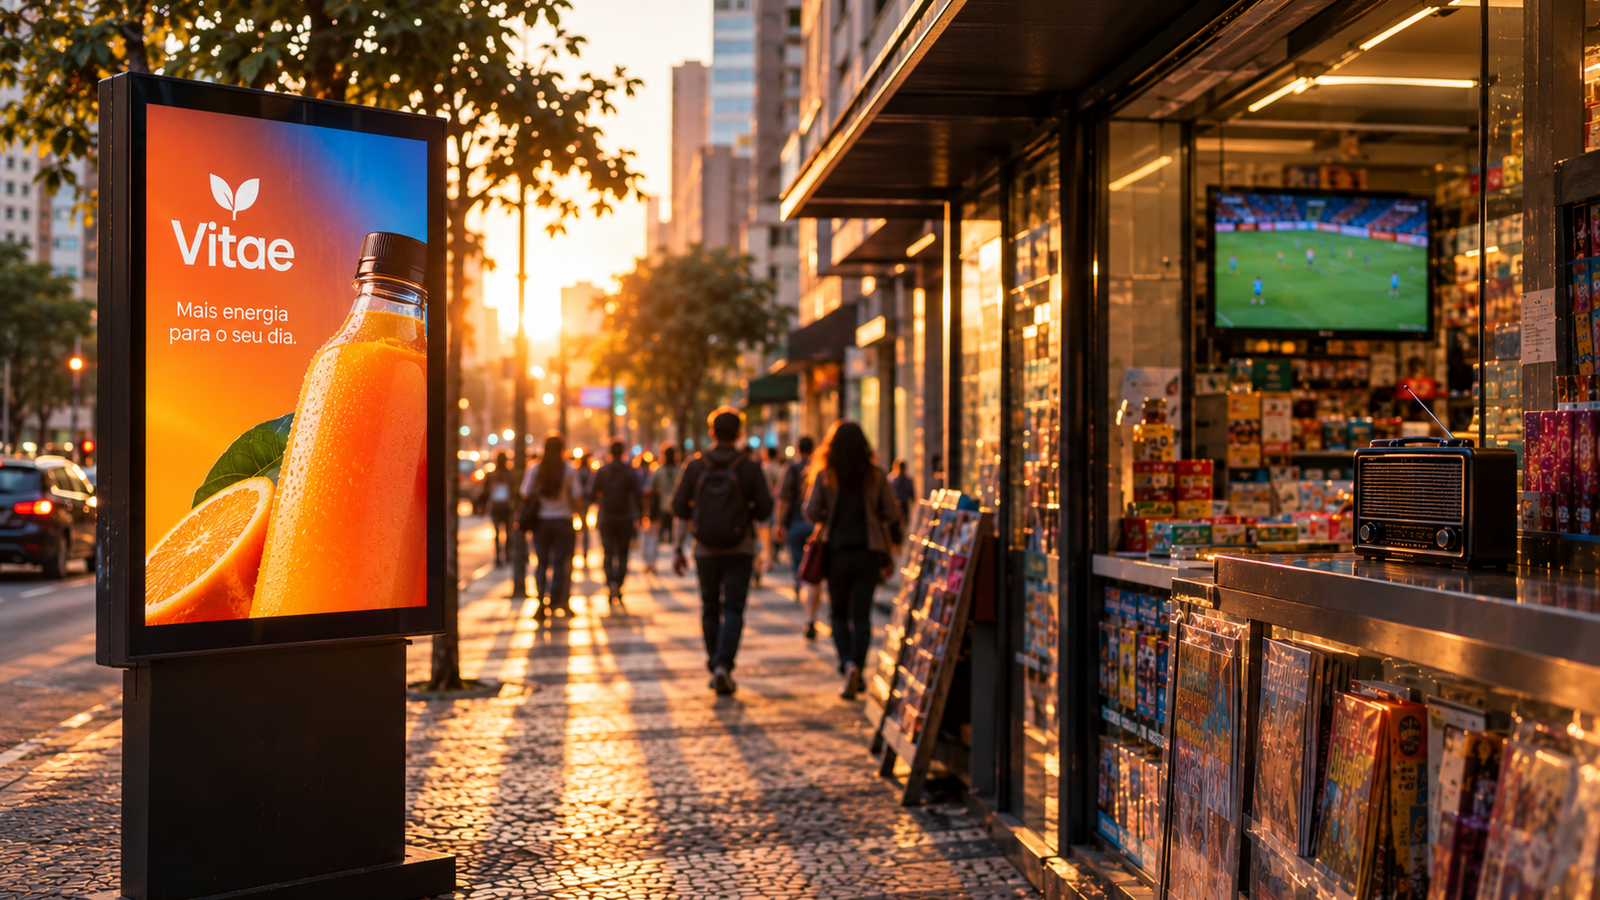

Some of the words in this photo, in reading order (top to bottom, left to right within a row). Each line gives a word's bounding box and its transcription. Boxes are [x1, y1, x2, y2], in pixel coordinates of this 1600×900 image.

[171, 219, 295, 272] Vitae
[176, 301, 218, 319] Mais
[222, 306, 288, 325] energia
[169, 326, 210, 345] para
[215, 330, 227, 342] o
[232, 330, 263, 344] seu
[267, 327, 297, 345] dia.
